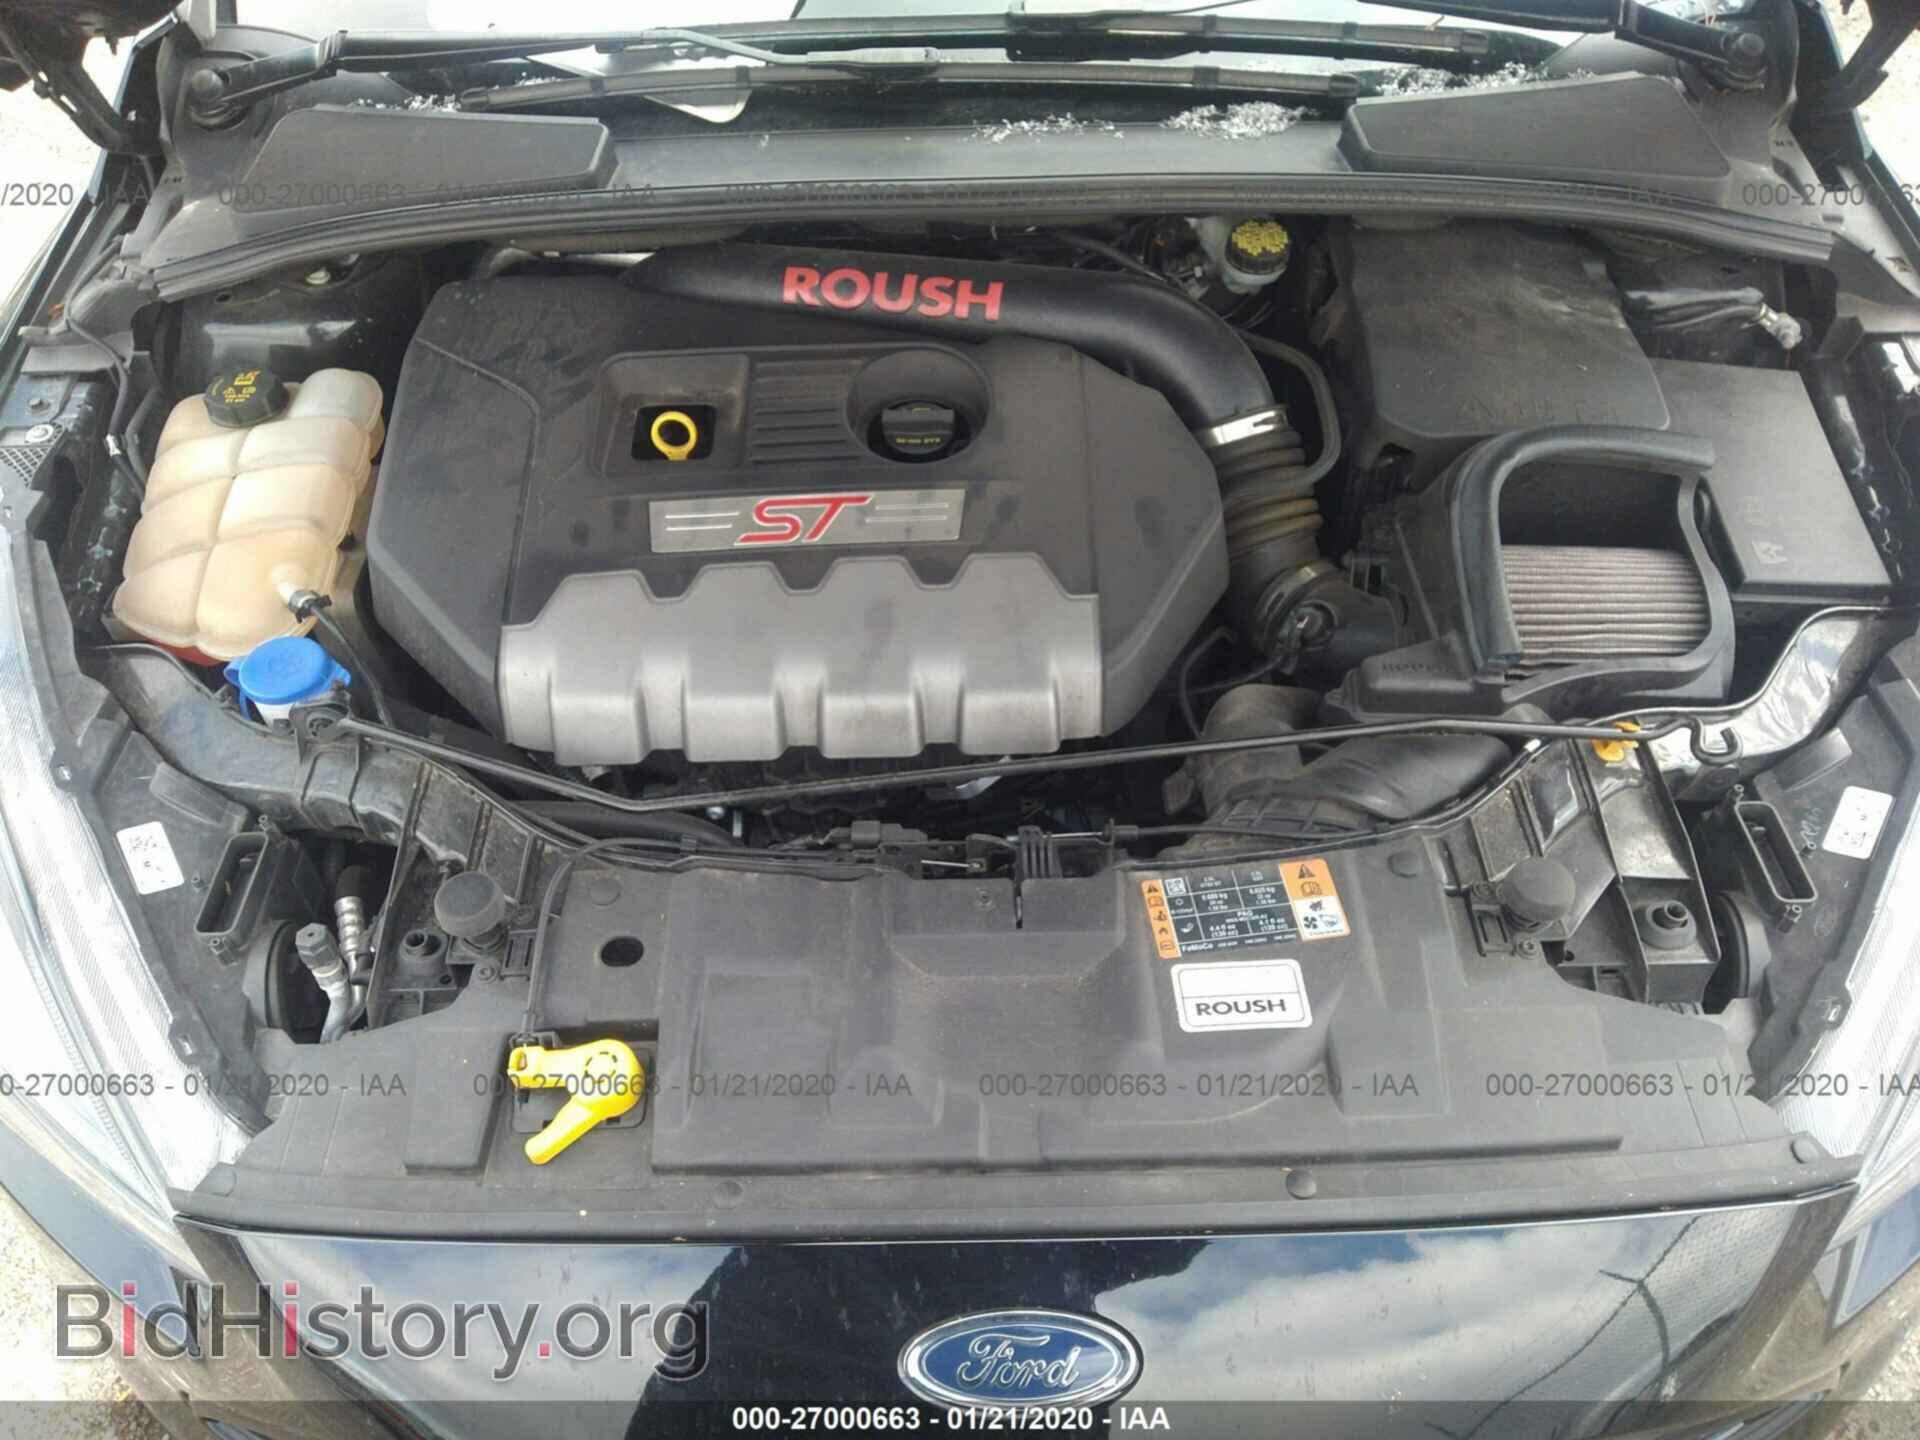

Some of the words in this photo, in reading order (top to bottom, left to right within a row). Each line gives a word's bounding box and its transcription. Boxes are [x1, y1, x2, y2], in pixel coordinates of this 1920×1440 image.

[783, 266, 1003, 320] ROUSH
[734, 495, 874, 546] ST
[1195, 999, 1287, 1016] ROUSH
[956, 1333, 1080, 1388] Ford
